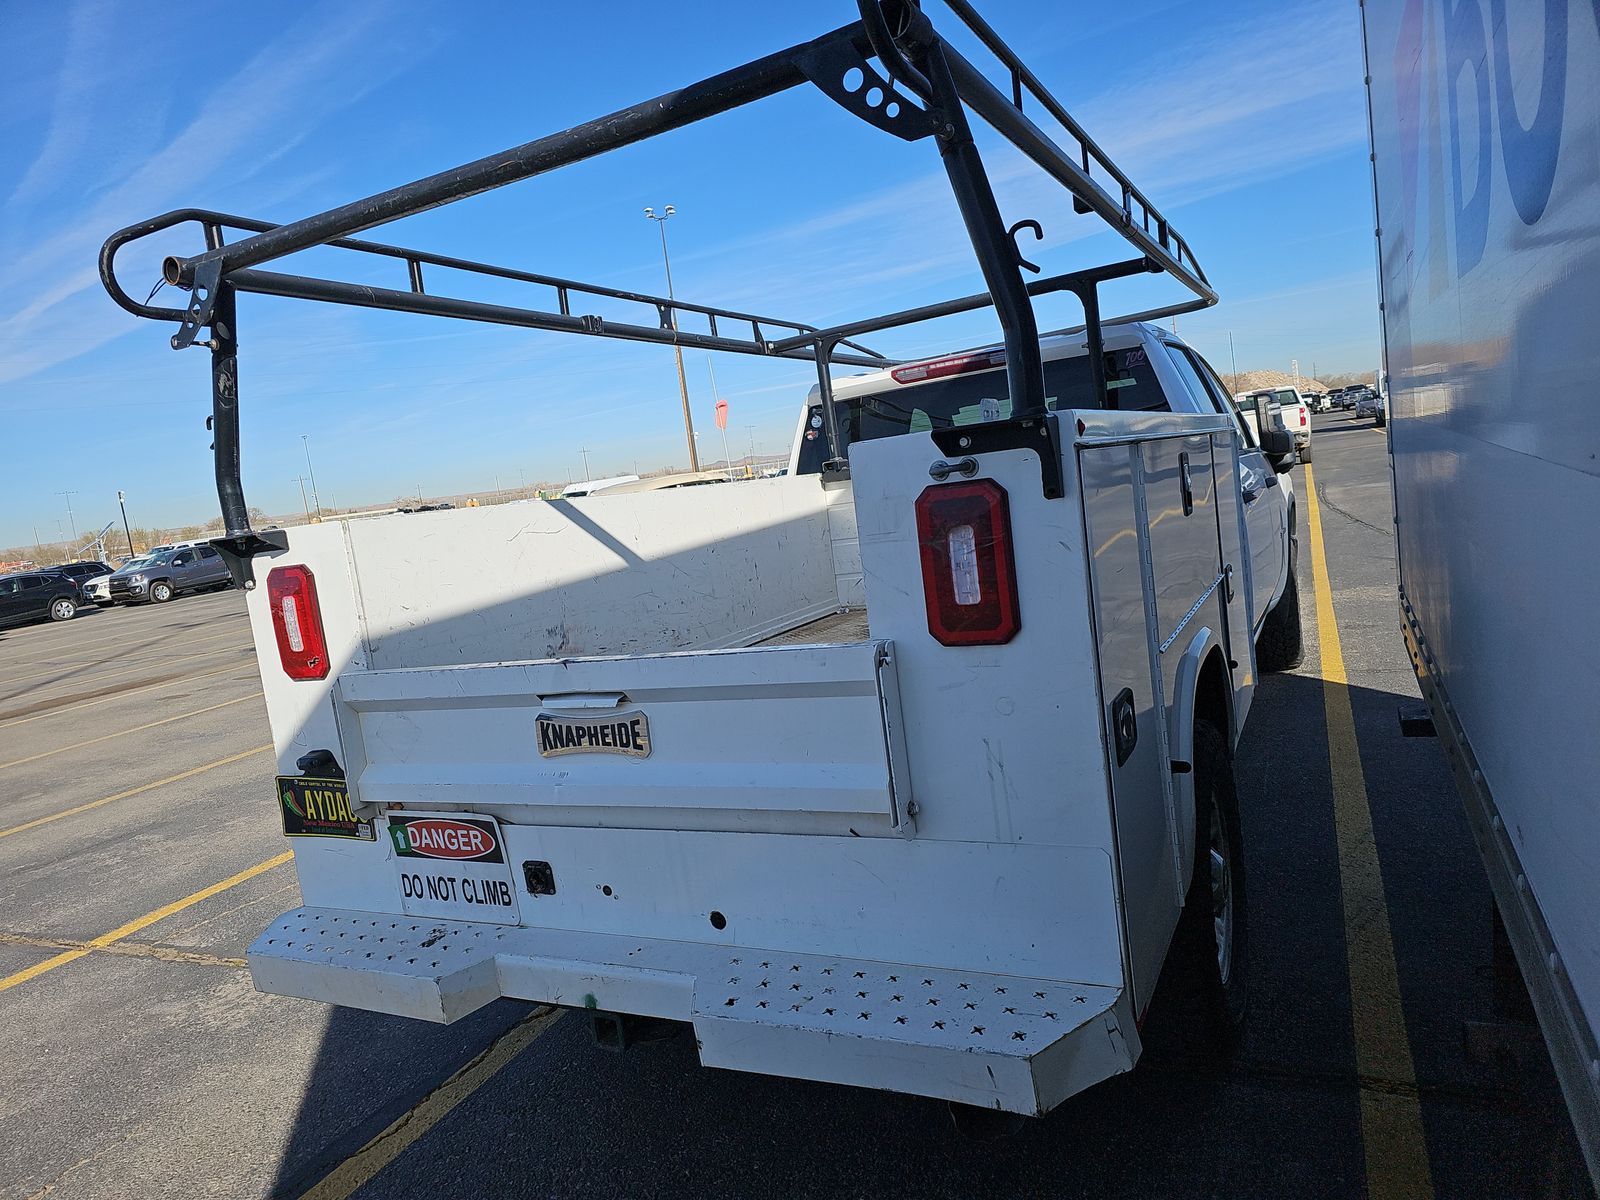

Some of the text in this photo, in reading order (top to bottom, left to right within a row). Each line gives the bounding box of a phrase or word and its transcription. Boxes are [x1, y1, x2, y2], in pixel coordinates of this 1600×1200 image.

[540, 718, 644, 751] KNAPHEIDE
[406, 826, 485, 851] DANGER
[401, 873, 512, 907] DO NOT CLIMB
